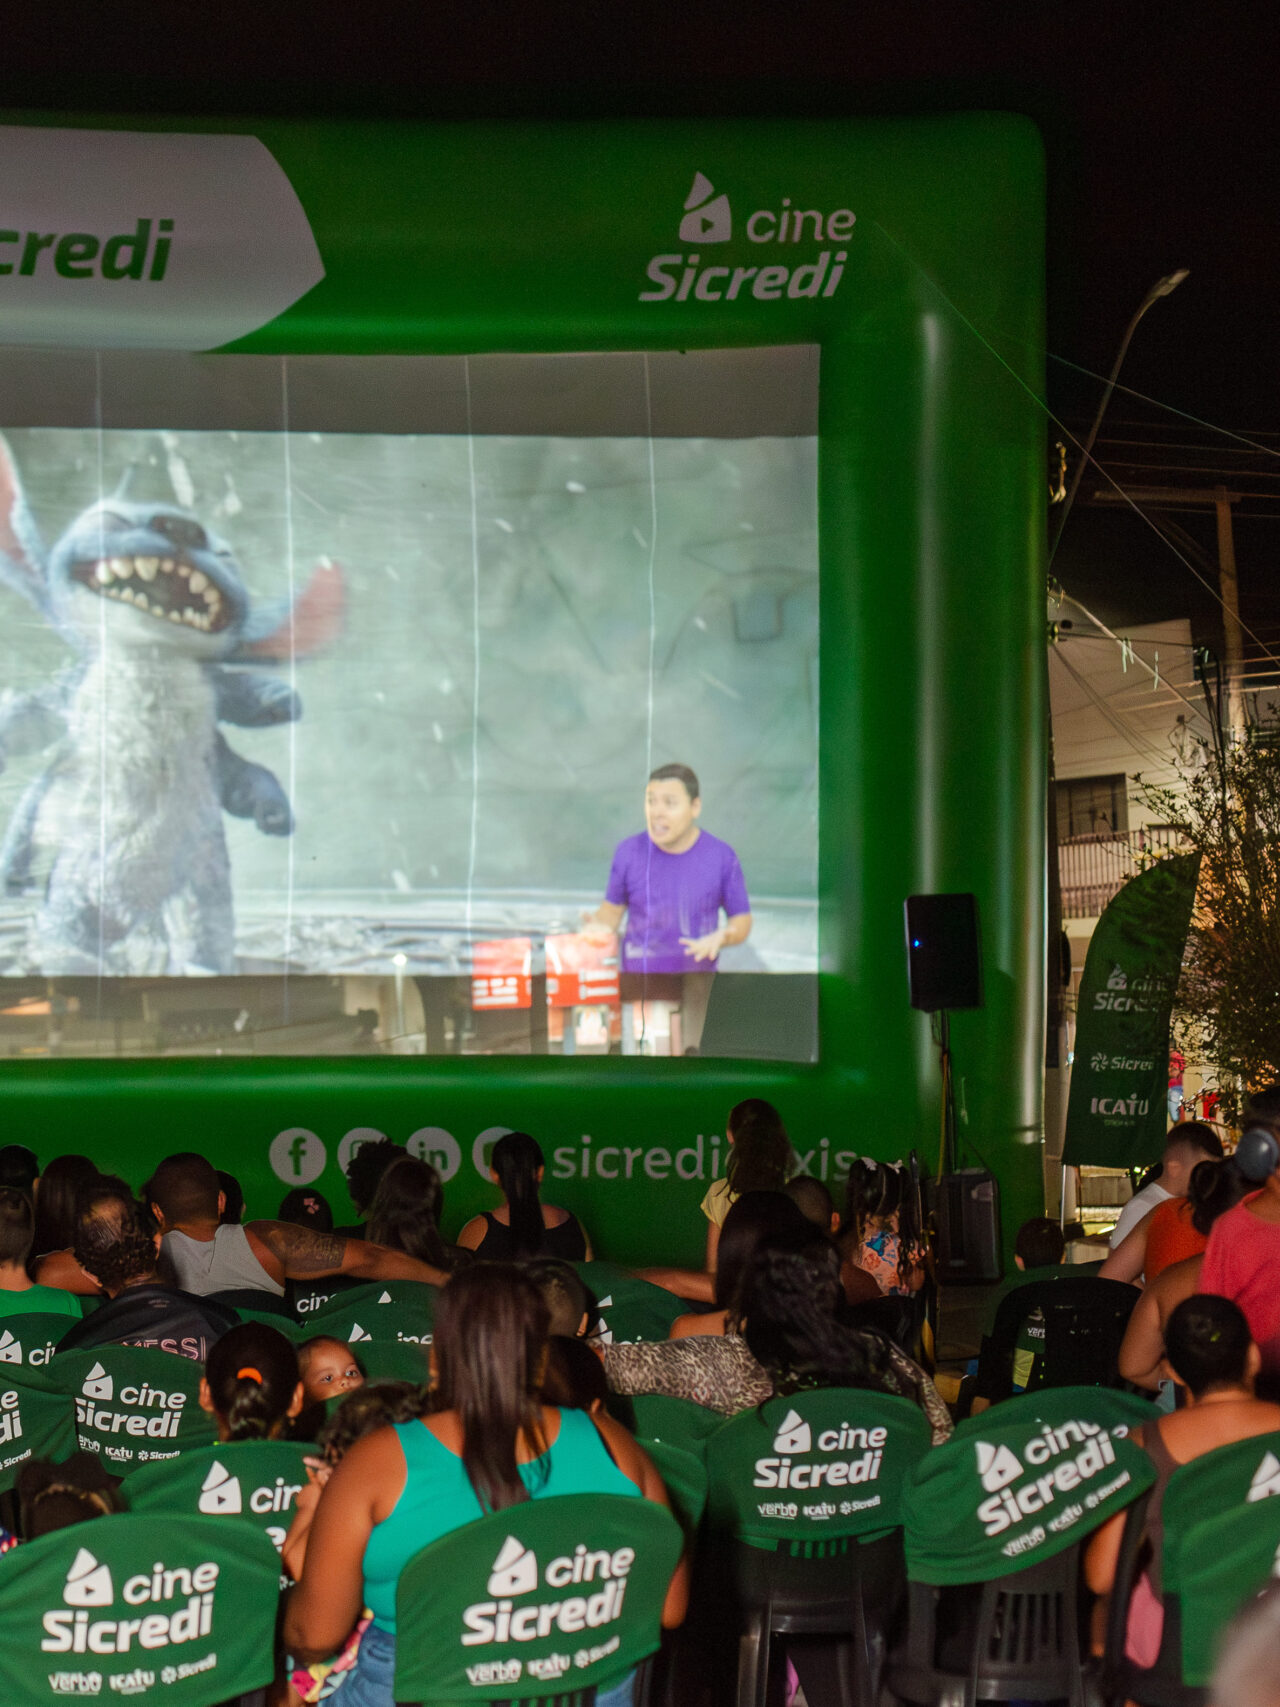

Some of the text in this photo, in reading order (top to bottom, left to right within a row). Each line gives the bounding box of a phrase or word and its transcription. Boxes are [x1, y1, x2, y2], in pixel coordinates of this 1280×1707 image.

[746, 198, 856, 243] cine
[638, 250, 847, 301] Sicredi
[1090, 1093, 1150, 1116] ICATU
[296, 1292, 337, 1313] cin
[120, 1382, 187, 1409] cine
[75, 1397, 182, 1437] Sicredi
[105, 1446, 133, 1459] ICATU
[817, 1421, 888, 1452] cine
[3, 1448, 32, 1468] Sicredi
[753, 1449, 883, 1490] Sicredi
[250, 1477, 302, 1513] cin
[976, 1430, 1116, 1537] Sicredi
[802, 1502, 836, 1516] ICATU
[122, 1561, 220, 1605] cine
[545, 1544, 636, 1587] cine
[41, 1592, 214, 1654] Sicredi
[461, 1577, 627, 1646] Sicredi
[109, 1668, 155, 1690] ICATU
